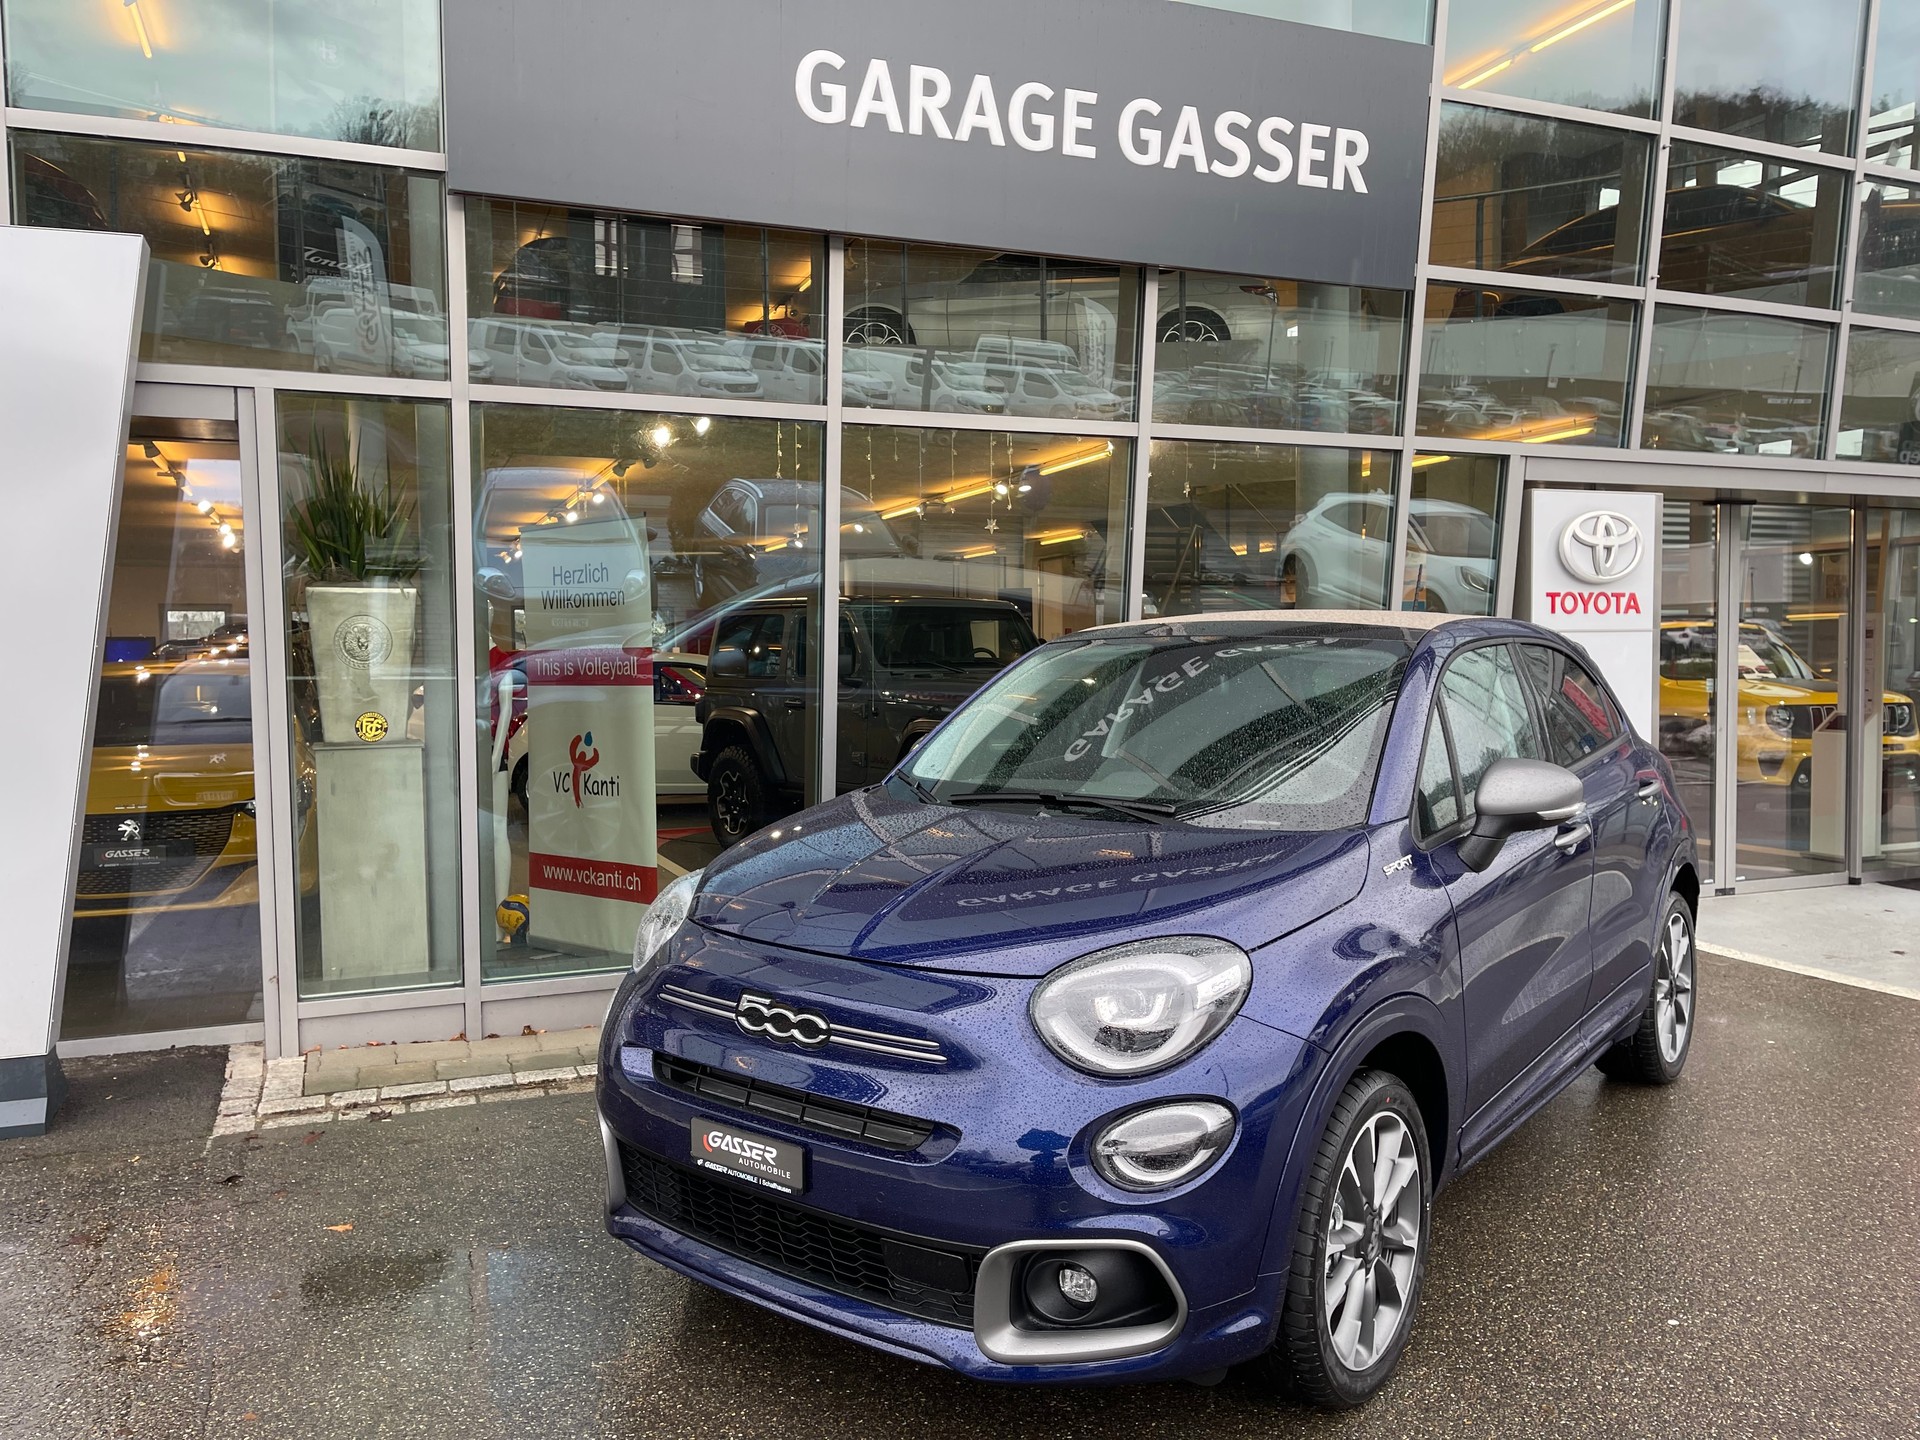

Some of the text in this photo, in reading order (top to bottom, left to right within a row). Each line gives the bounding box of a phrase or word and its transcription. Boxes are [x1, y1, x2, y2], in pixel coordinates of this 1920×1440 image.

[794, 49, 1370, 194] GARAGE GASSER
[552, 562, 609, 586] Herzlich
[541, 589, 625, 610] Willkommen
[1545, 591, 1641, 614] TOYOTA
[535, 656, 637, 680] This is Volleyball
[553, 771, 620, 796] VC Kanti
[105, 849, 150, 858] GASSER
[1383, 854, 1412, 876] SPORT
[543, 864, 641, 891] www.vckanti.ch
[738, 994, 828, 1044] 500
[707, 1131, 777, 1165] GASSER
[704, 1161, 728, 1174] GASSER
[727, 1168, 758, 1184] AUTOMOBILE
[762, 1179, 792, 1194] Schaffhausen
[738, 1157, 791, 1180] AUTOMOBILE
